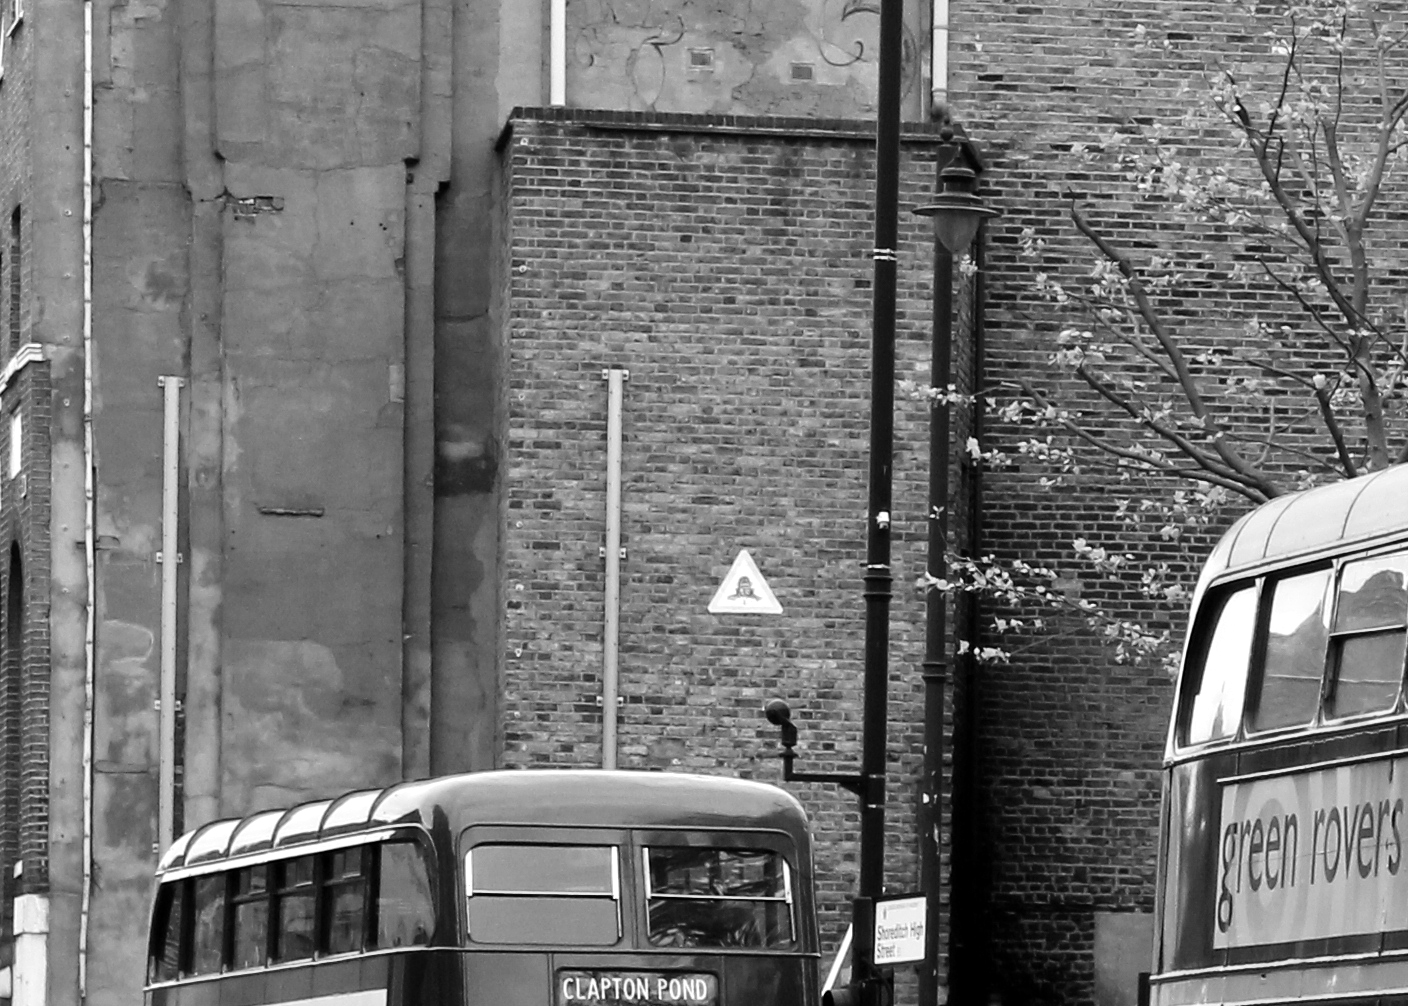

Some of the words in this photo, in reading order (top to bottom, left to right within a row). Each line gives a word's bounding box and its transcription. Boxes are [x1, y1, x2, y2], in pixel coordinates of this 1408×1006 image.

[1218, 813, 1298, 933] green
[1311, 798, 1404, 884] rovers
[910, 920, 924, 941] High
[563, 977, 649, 1000] CLAPTON
[657, 978, 708, 1001] POND
